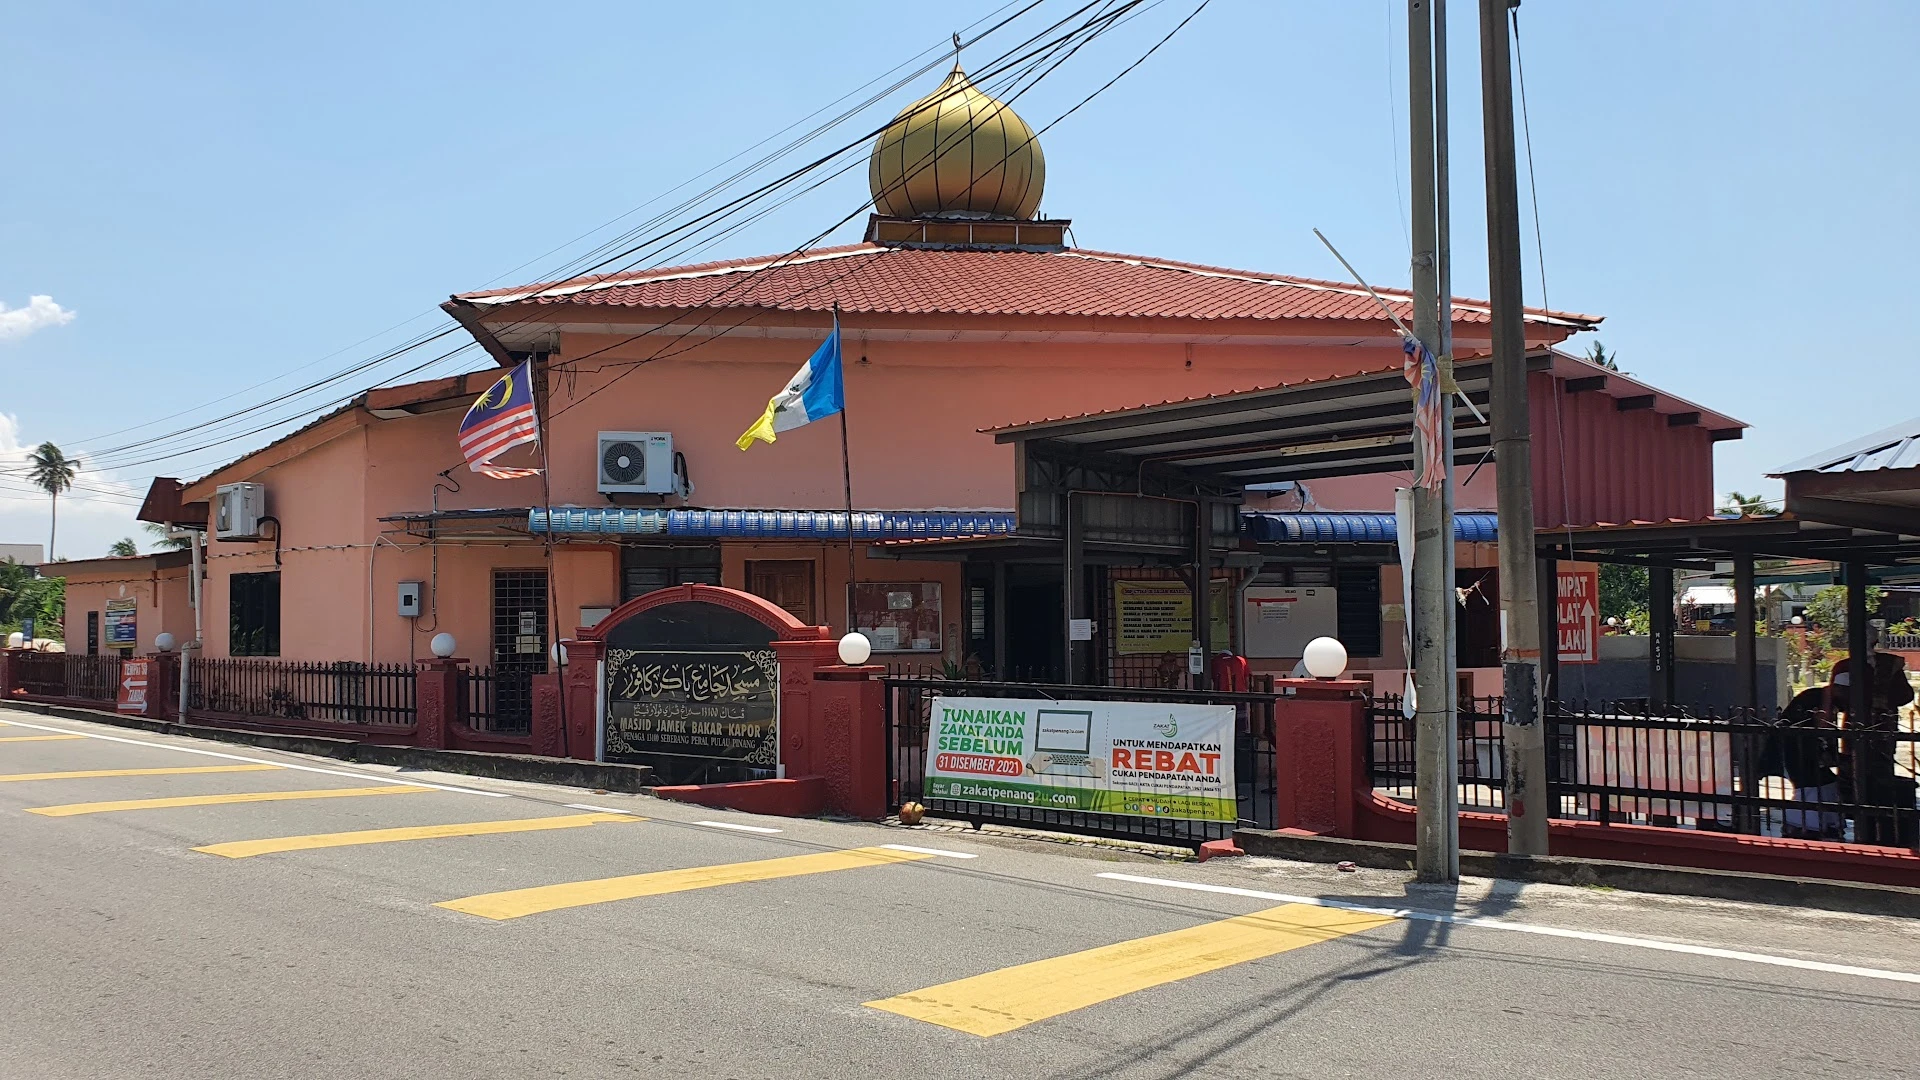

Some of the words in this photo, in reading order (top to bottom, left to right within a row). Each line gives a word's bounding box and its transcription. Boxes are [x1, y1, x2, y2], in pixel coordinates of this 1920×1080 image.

[1558, 629, 1586, 651] LAKI
[942, 708, 1026, 726] TUNAIKAN
[620, 718, 652, 732] MASJID
[656, 720, 686, 734] JAMEK
[692, 722, 722, 736] BAKAR
[728, 723, 760, 738] KAPOR
[940, 723, 982, 737] ZAKAT
[984, 726, 1024, 740] ANDA
[624, 732, 646, 742] PENAGA
[660, 734, 690, 744] SEBERANG
[710, 736, 730, 747] PULAU
[732, 738, 756, 749] PINANG
[938, 737, 1023, 756] SEBELUM
[1112, 739, 1145, 748] UNTUK
[1146, 740, 1221, 752] MENDAPATKAN
[938, 756, 948, 768] 31
[950, 756, 995, 772] DISEMBER
[996, 760, 1019, 774] 2021
[1112, 748, 1220, 774] REBAT
[1112, 770, 1137, 778] CUKAI
[1138, 772, 1195, 782] PENDAPATAN
[1196, 775, 1221, 784] ANDA
[963, 784, 1077, 804] zakatpenang2u.com
[1171, 808, 1215, 816] zakatpenang
